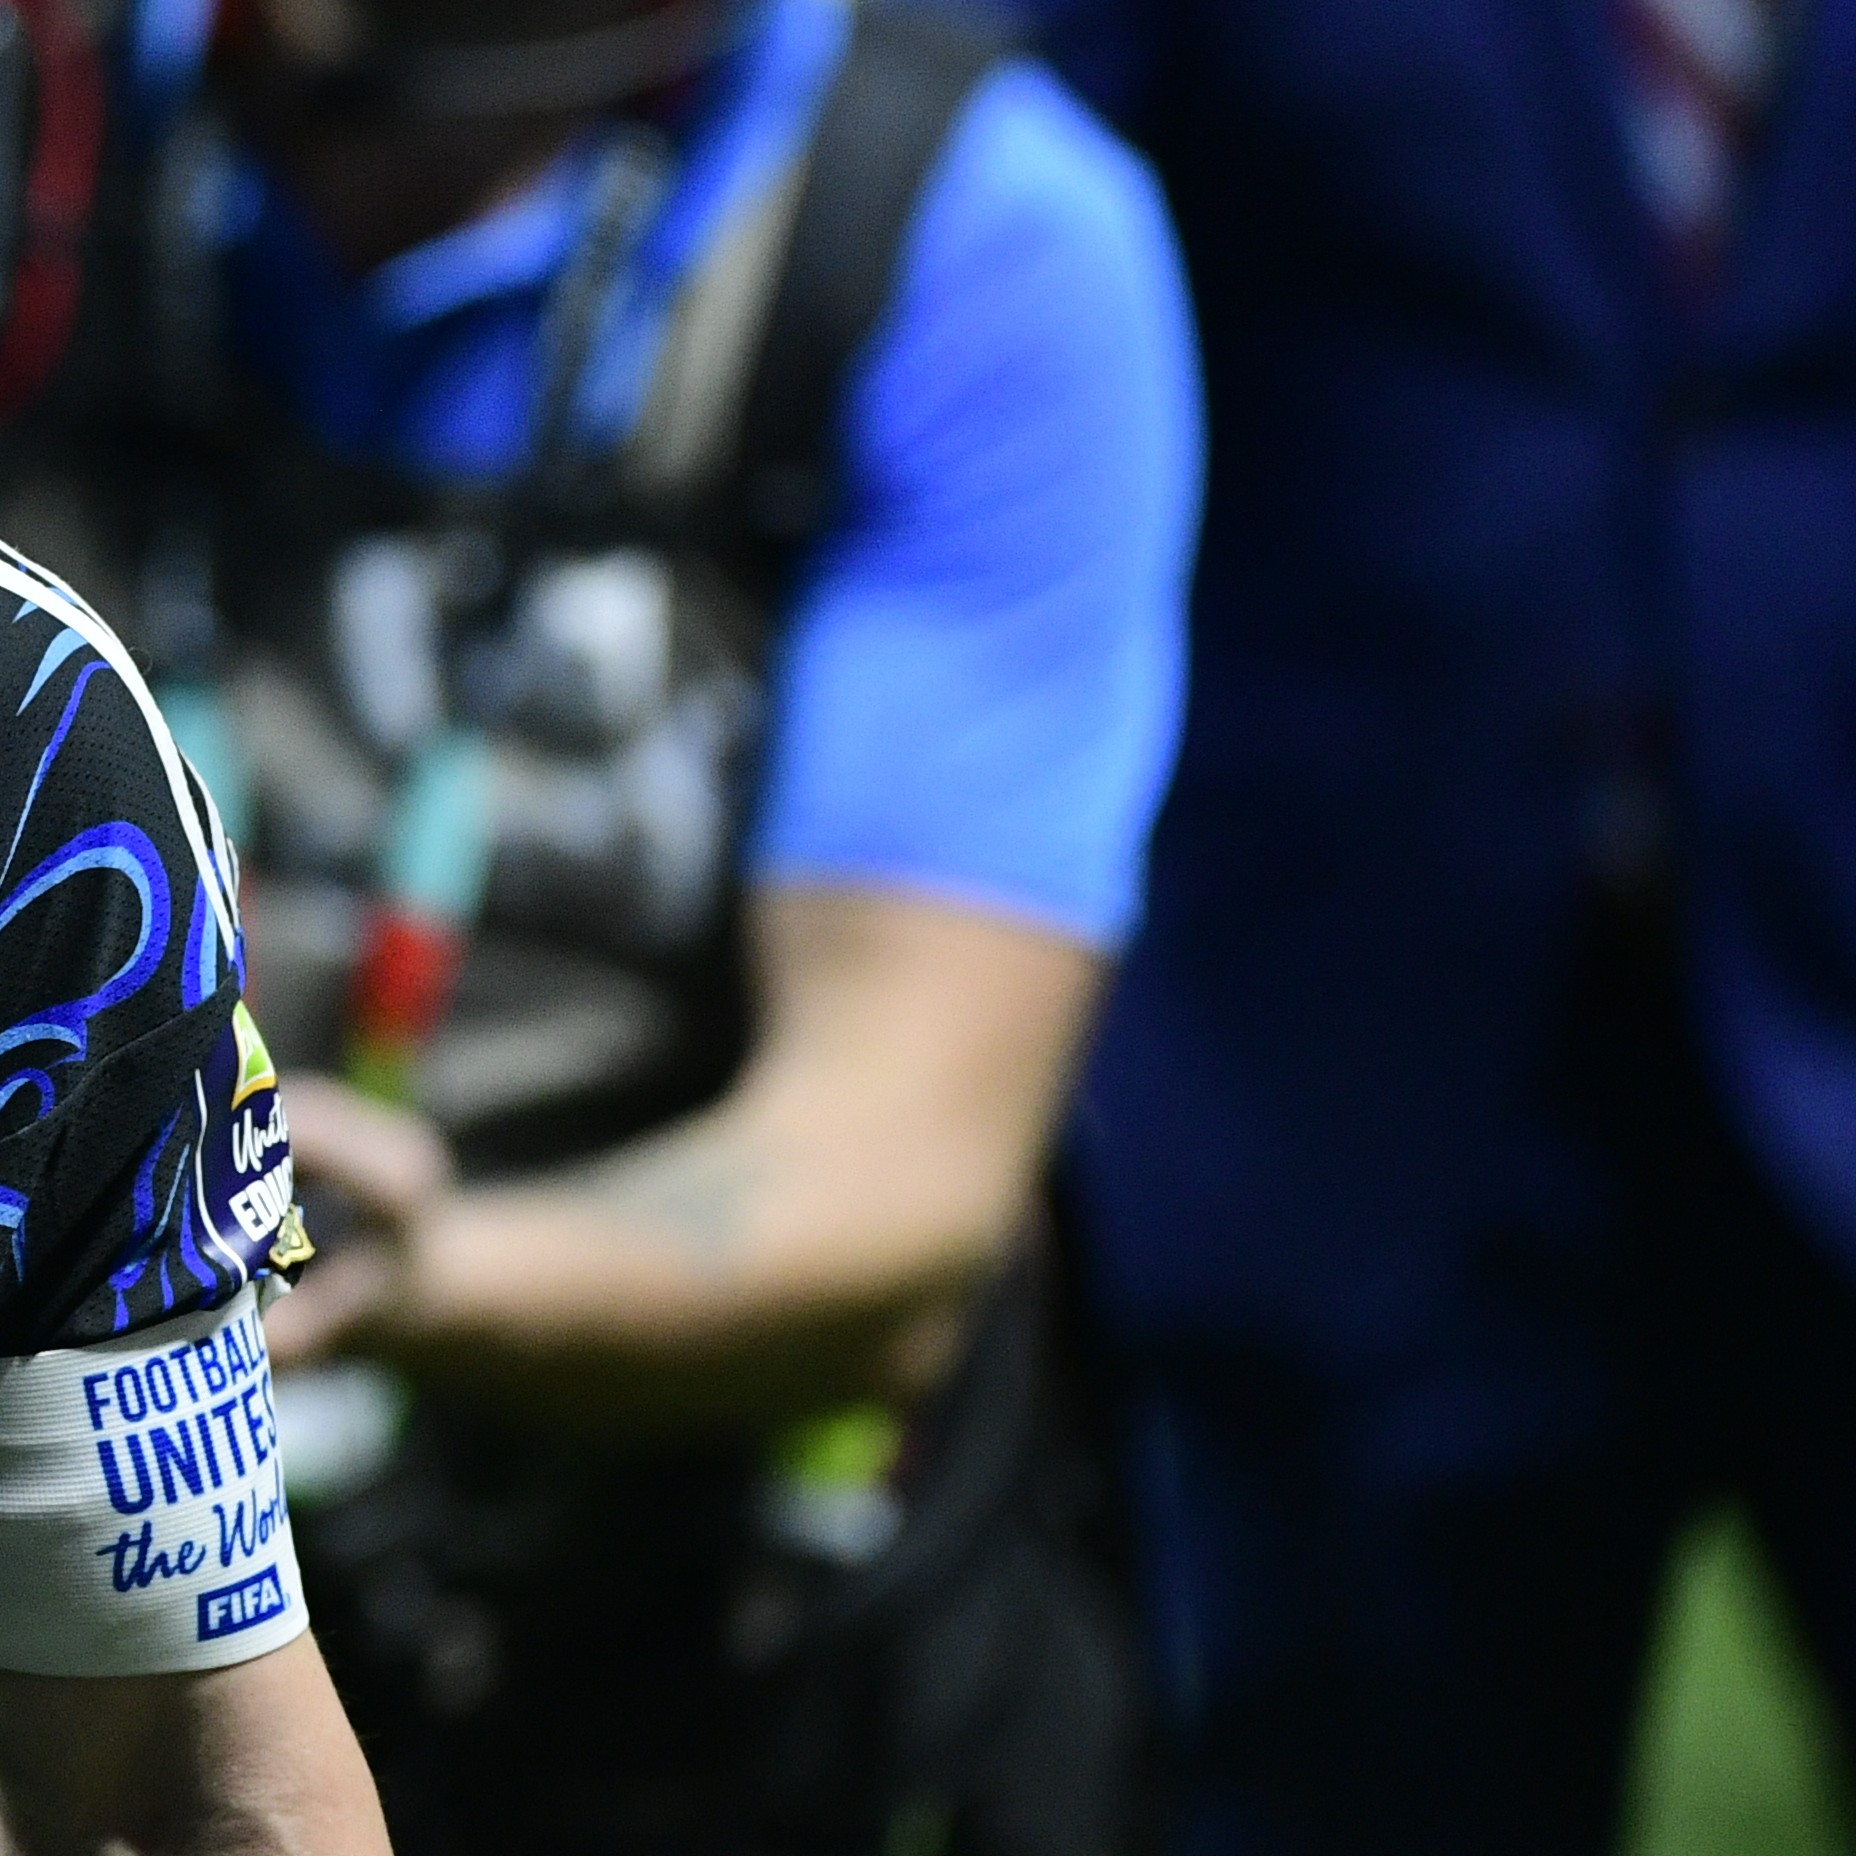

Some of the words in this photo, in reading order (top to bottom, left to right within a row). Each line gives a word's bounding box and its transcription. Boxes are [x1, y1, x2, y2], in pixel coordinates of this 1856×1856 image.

[83, 1308, 266, 1431] FOOTBALL
[96, 1370, 278, 1514] UNITES
[94, 1521, 207, 1593] the
[211, 1457, 288, 1568] Worl
[205, 1574, 282, 1632] FIFA
